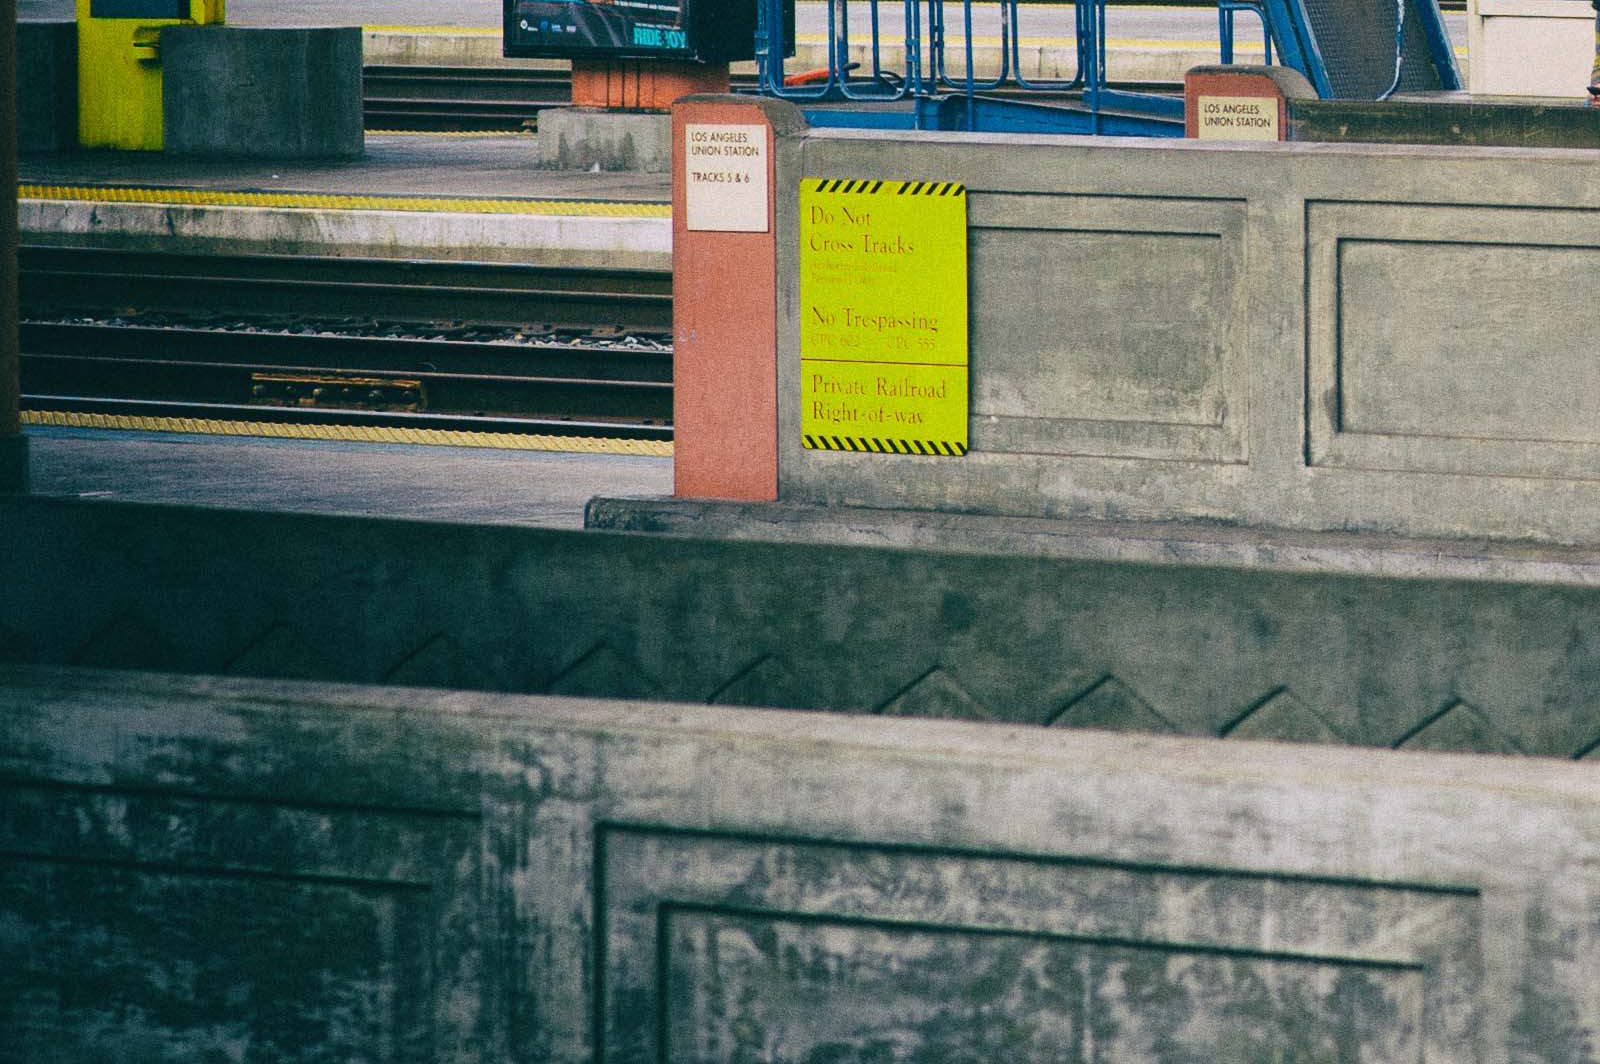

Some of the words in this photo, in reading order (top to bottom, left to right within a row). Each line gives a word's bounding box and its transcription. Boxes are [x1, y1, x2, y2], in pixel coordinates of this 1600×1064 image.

[1204, 103, 1220, 114] LOS
[1222, 104, 1260, 115] ANGELES
[1204, 117, 1234, 127] UNION
[1236, 117, 1271, 128] STATION
[691, 132, 708, 143] LOS
[710, 133, 748, 143] ANGELES
[691, 145, 721, 156] UNION
[724, 146, 760, 157] STATION
[691, 172, 725, 183] TRACKS
[727, 173, 732, 184] 5
[735, 173, 741, 183] &
[744, 173, 750, 184] 6
[810, 205, 835, 226] Do
[841, 206, 871, 227] Not
[809, 232, 854, 253] Cross
[863, 234, 914, 255] Tracks
[812, 306, 836, 327] No
[843, 307, 939, 333] Trespassing
[812, 373, 868, 396] Private
[876, 376, 947, 400] Railroad
